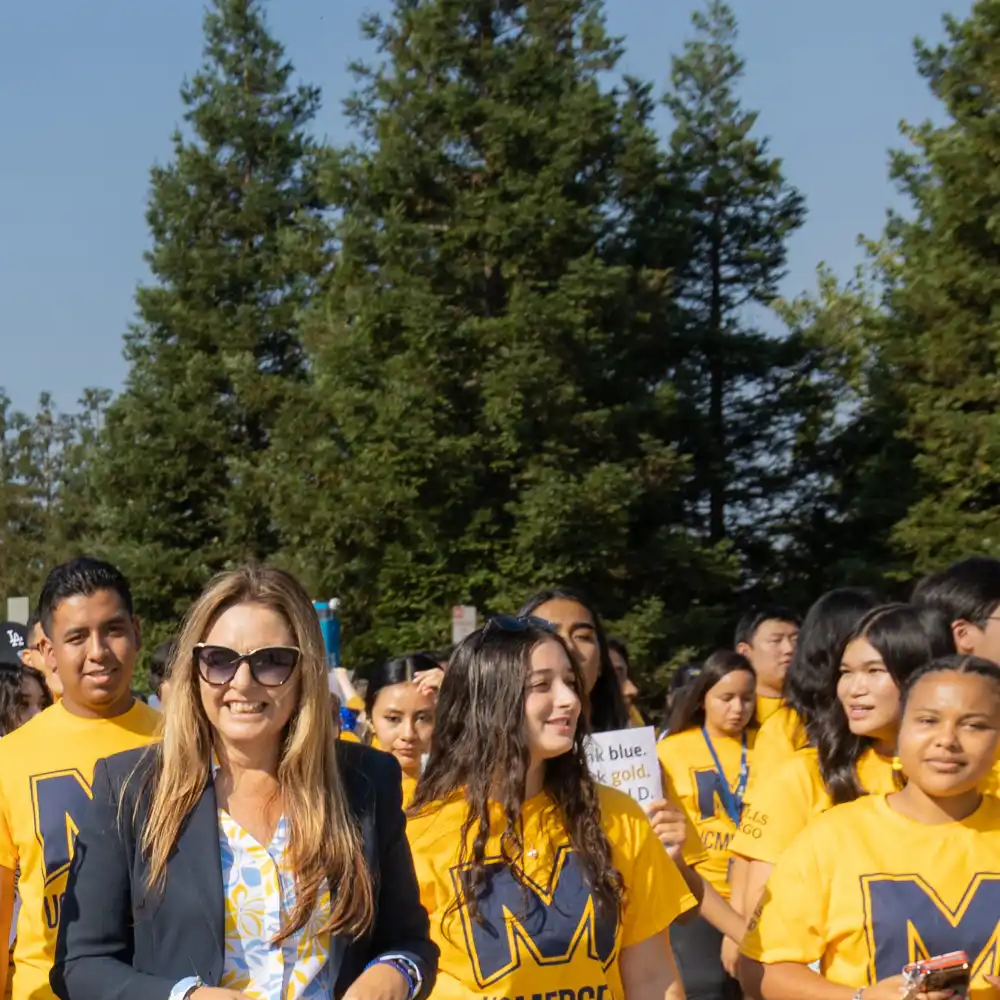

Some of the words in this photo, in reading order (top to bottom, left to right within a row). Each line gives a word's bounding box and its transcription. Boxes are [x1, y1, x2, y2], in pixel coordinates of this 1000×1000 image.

[6, 629, 25, 648] LA
[609, 742, 647, 761] blue.
[611, 763, 651, 787] gold.
[449, 844, 623, 990] M
